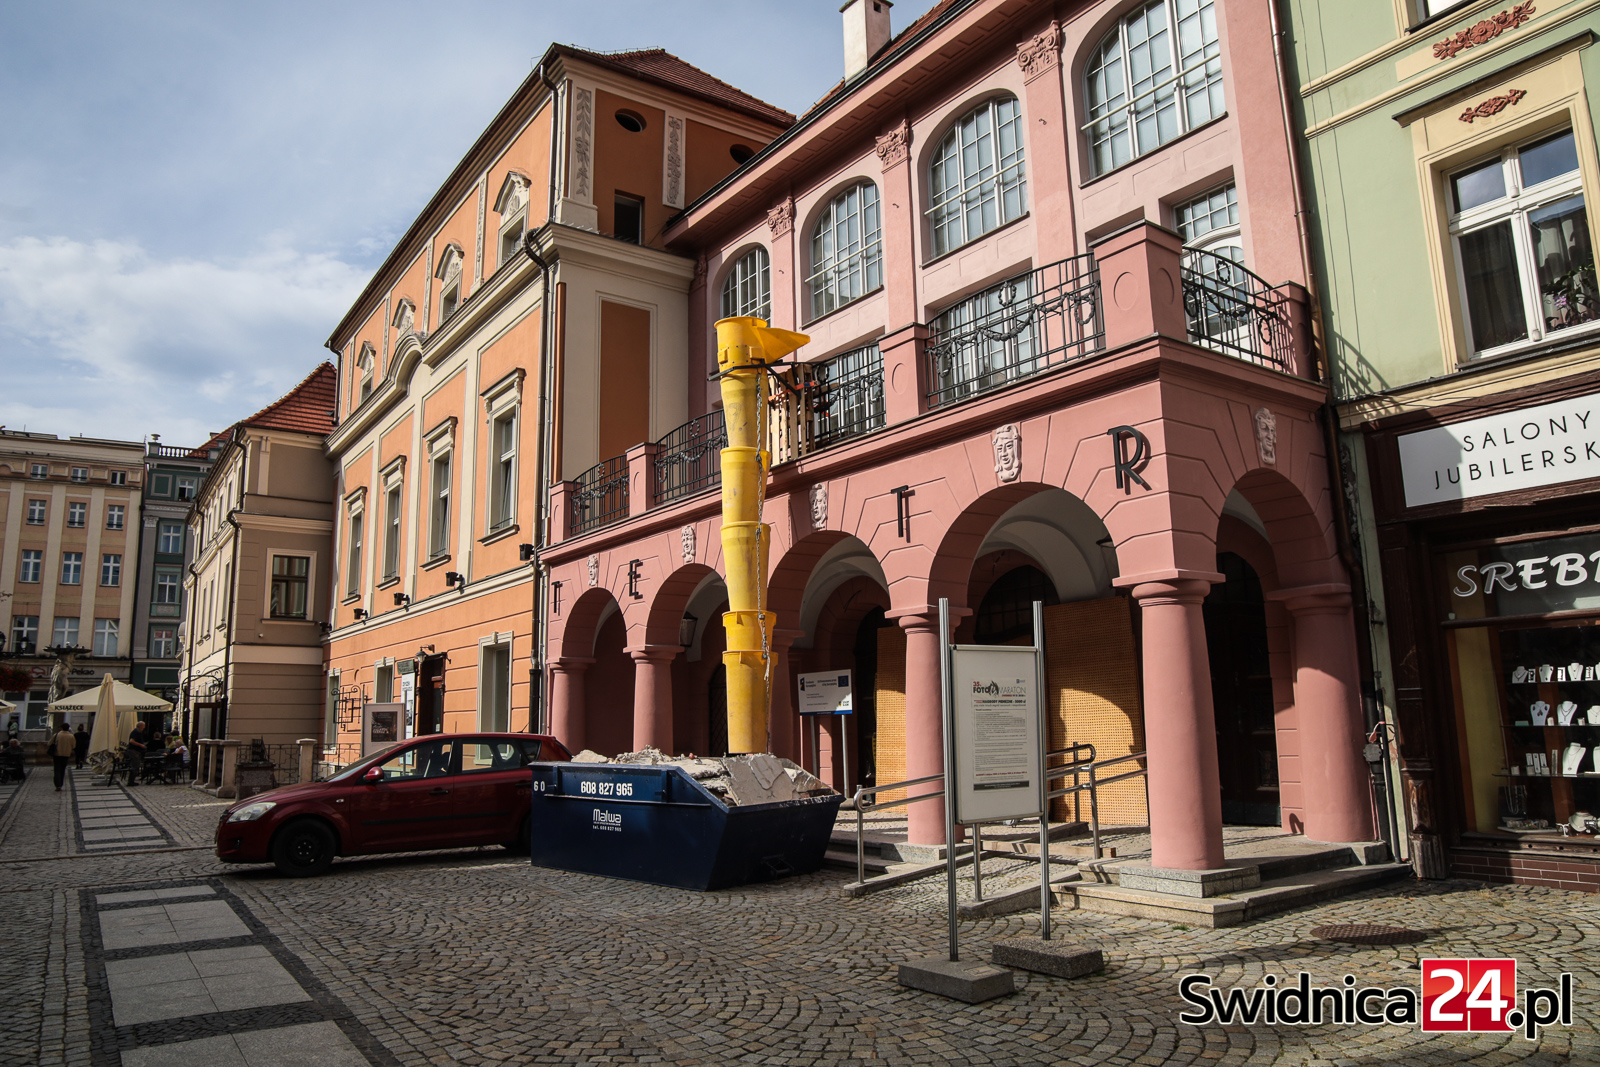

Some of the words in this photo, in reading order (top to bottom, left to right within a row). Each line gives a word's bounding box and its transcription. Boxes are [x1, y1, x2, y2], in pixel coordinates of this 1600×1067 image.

[1462, 410, 1591, 452] SALONY
[71, 668, 95, 676] Pekao
[580, 781, 597, 795] 608
[598, 782, 614, 796] 827
[616, 783, 633, 797] 965
[593, 808, 622, 824] Malwa
